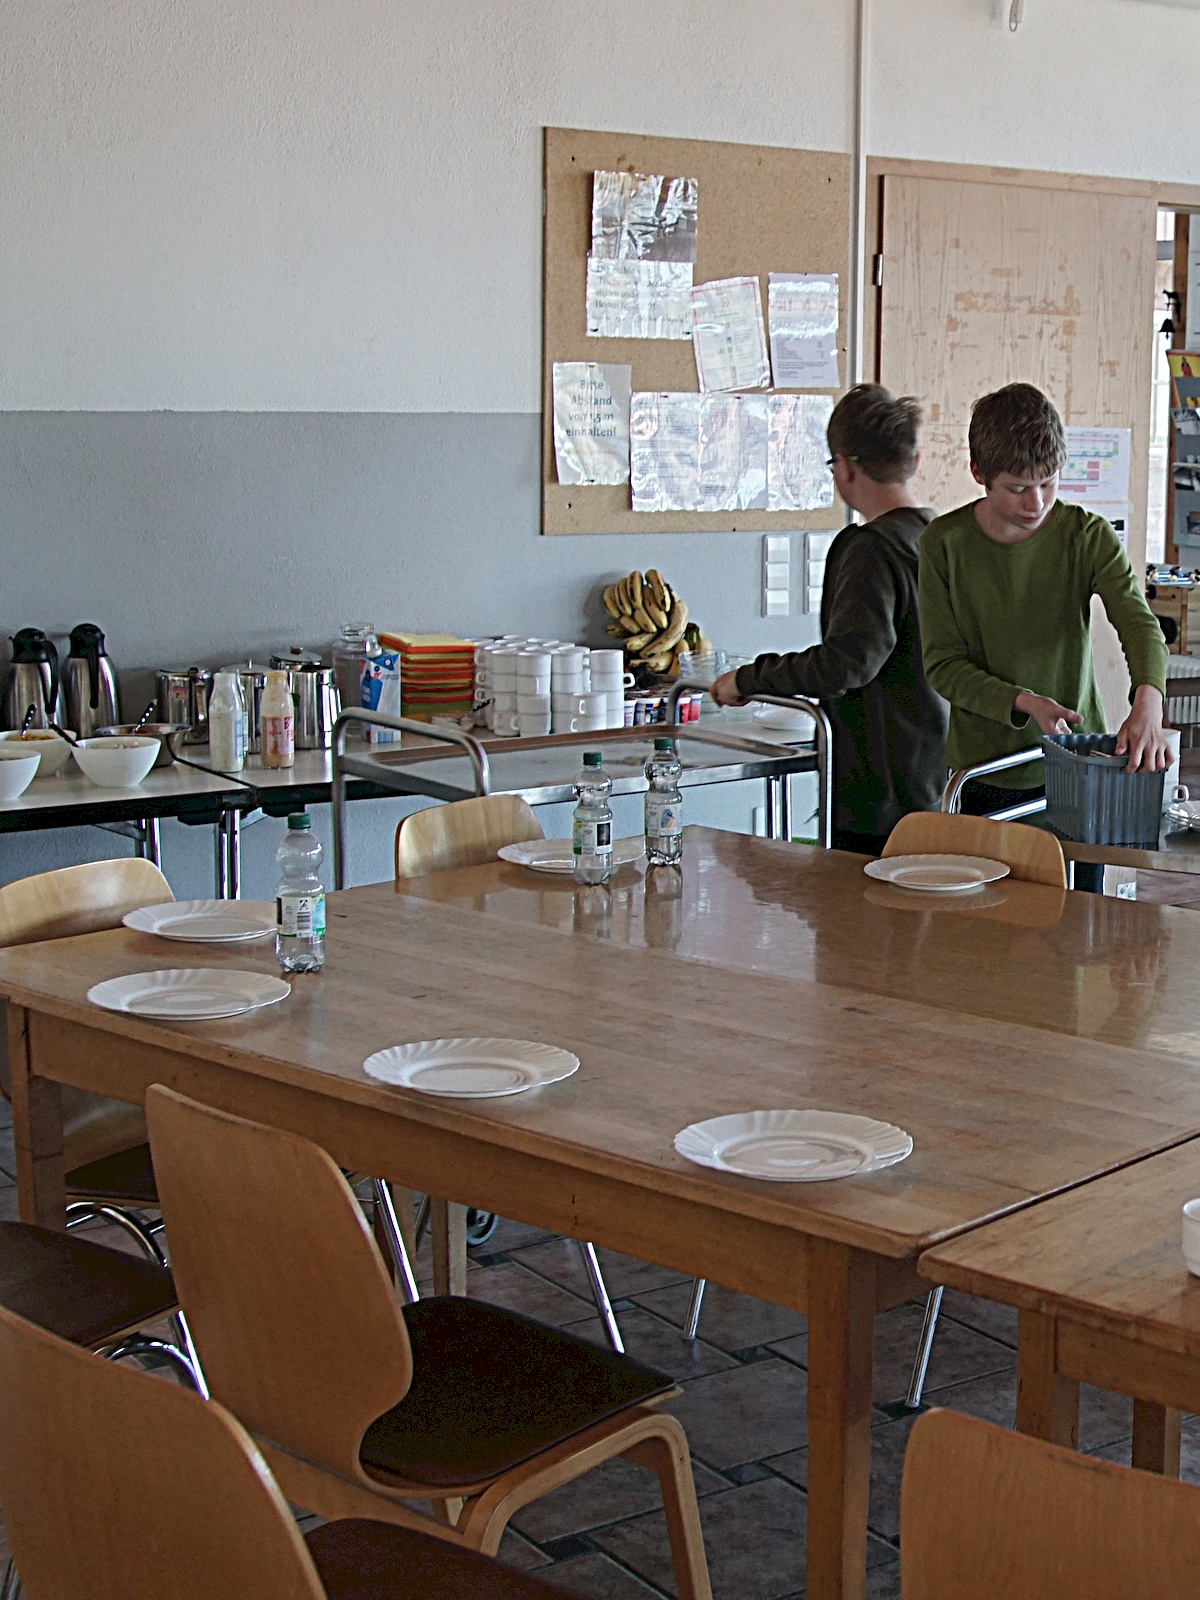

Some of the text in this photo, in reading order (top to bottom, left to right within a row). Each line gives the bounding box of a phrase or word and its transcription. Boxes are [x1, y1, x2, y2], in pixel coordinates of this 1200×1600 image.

[595, 299, 619, 309] Boden
[579, 379, 604, 391] Bitte
[570, 393, 613, 406] Abstand
[568, 412, 614, 424] von 1,5 m
[565, 425, 617, 438] einhalten!
